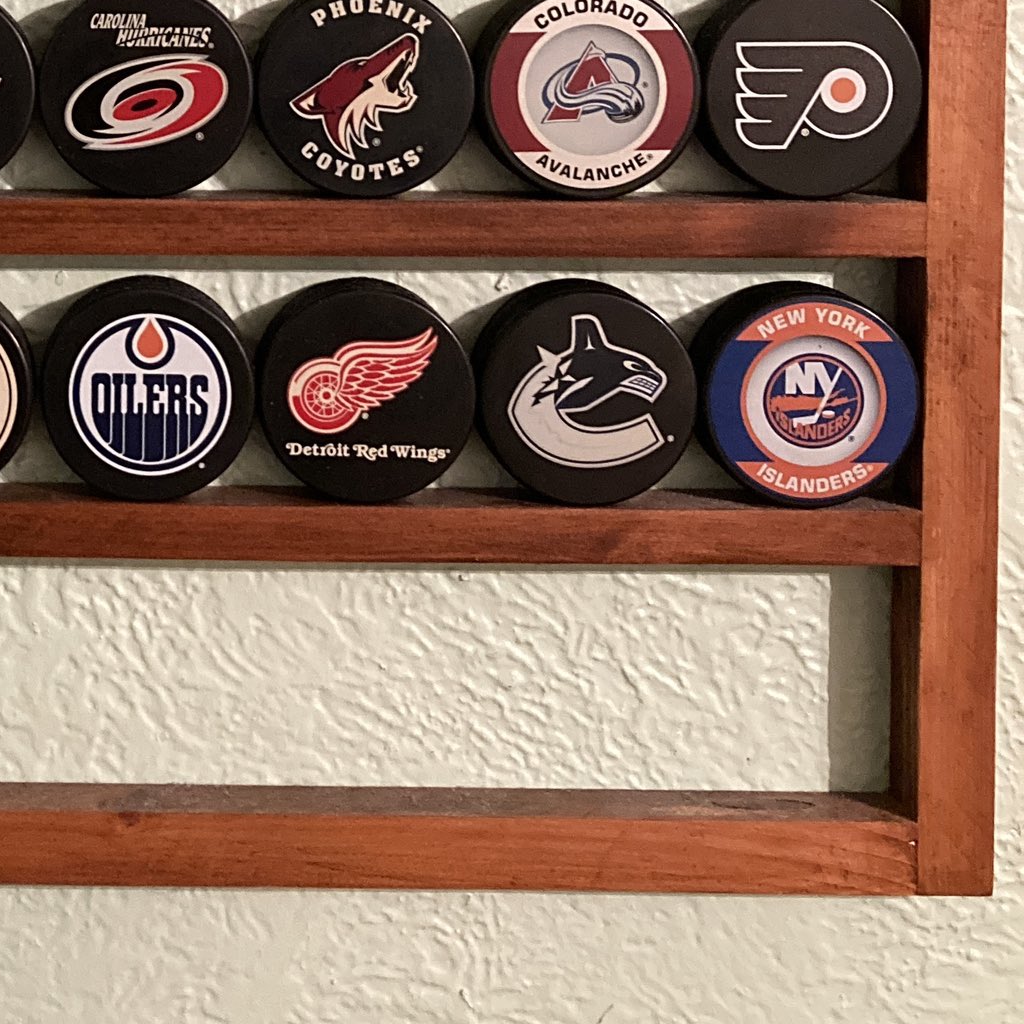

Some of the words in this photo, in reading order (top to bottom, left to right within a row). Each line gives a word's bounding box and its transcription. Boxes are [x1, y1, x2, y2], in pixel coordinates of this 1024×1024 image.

[90, 13, 147, 30] CAROLINA
[115, 27, 211, 48] HURRICANES
[301, 141, 420, 181] COYOTES
[536, 153, 648, 181] AVALANCHE
[757, 308, 806, 340] NEW
[815, 308, 870, 339] YORK
[91, 373, 209, 418] OILERS
[776, 408, 852, 440] ISLANDERS
[286, 442, 350, 458] Detroit
[352, 445, 388, 460] Red
[389, 444, 447, 462] Wings
[757, 464, 868, 493] ISLANDERS
